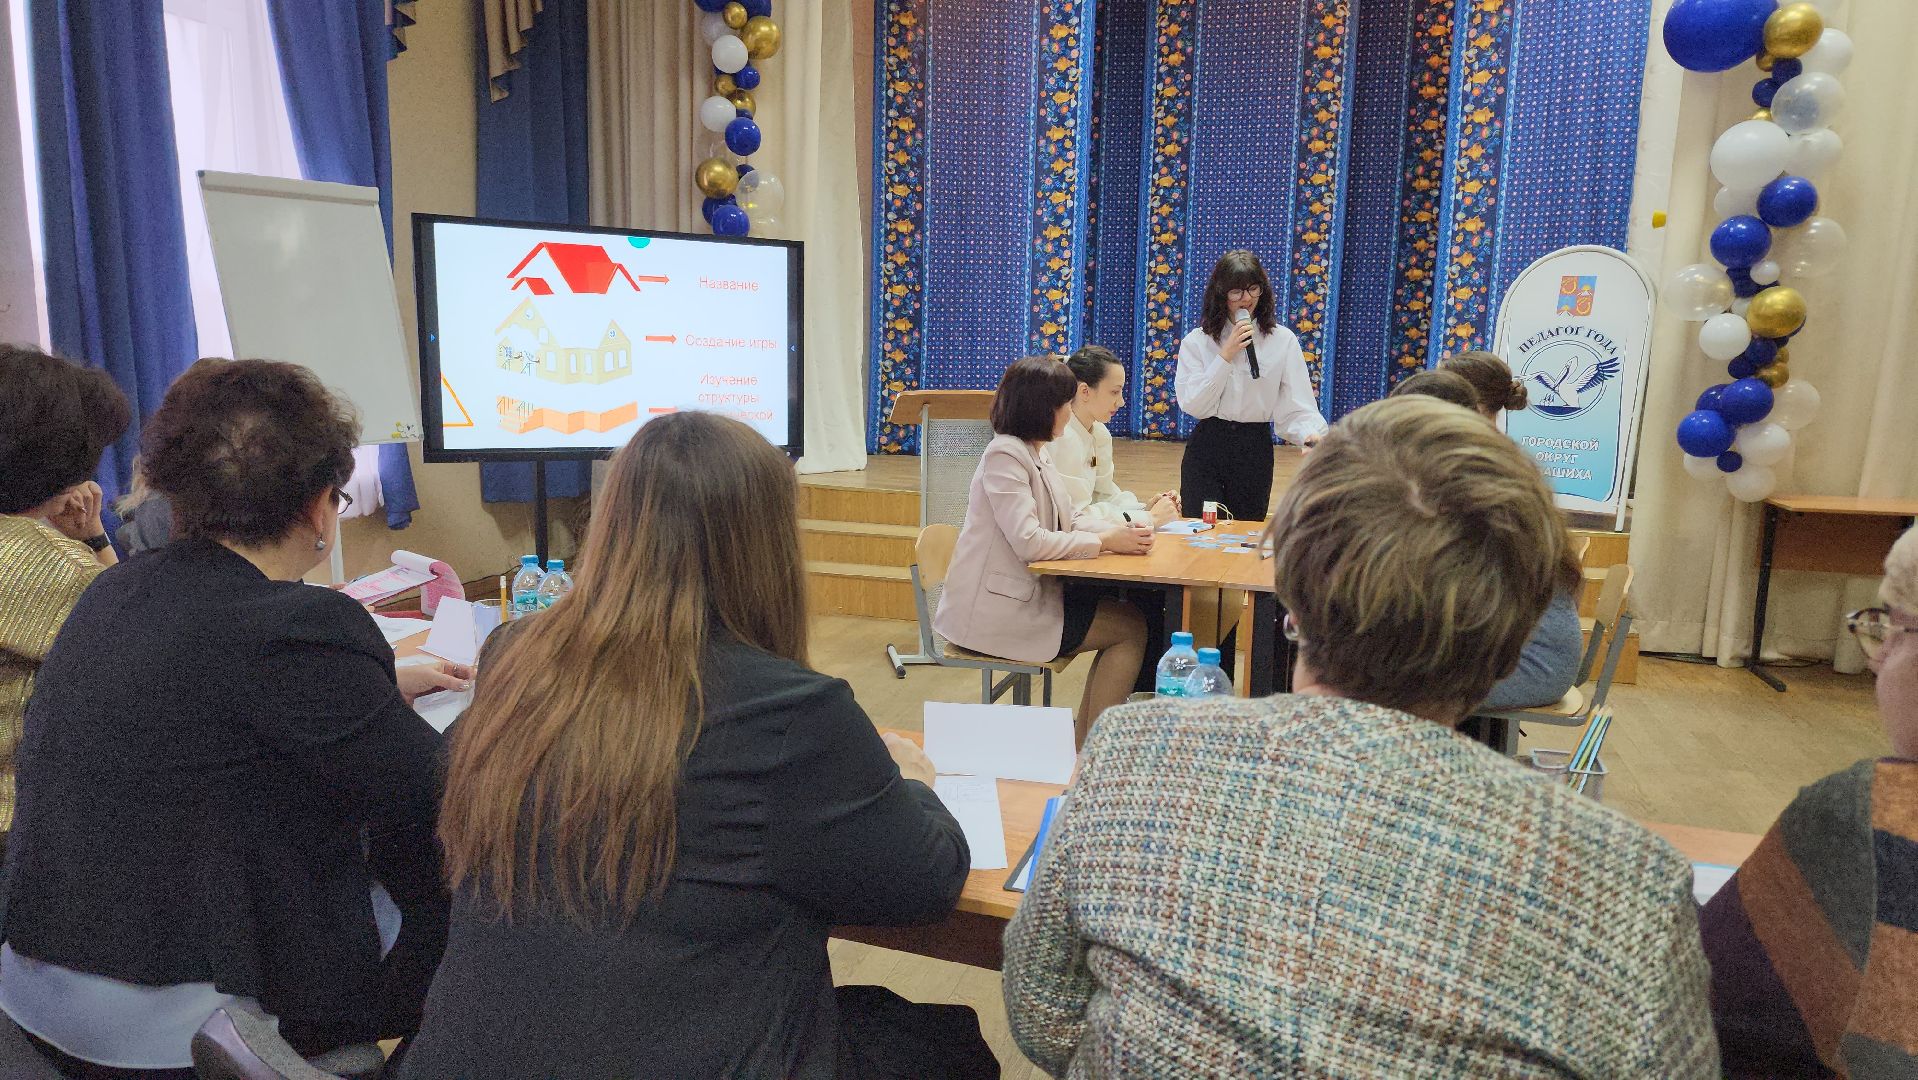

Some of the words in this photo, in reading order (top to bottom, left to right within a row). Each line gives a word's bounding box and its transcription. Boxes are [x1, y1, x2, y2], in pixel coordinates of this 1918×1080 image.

[699, 275, 759, 292] Название
[685, 334, 746, 347] Создание
[749, 338, 777, 351] игры
[1518, 325, 1584, 353] ПЕДАГОГ
[1586, 328, 1618, 355] ГОДА
[700, 372, 758, 388] Изучение
[698, 392, 760, 405] структуры
[1521, 436, 1599, 451] ГОРОДСКОЙ
[1535, 451, 1579, 464] ОКРУГ
[1543, 466, 1593, 481] АШИХА
